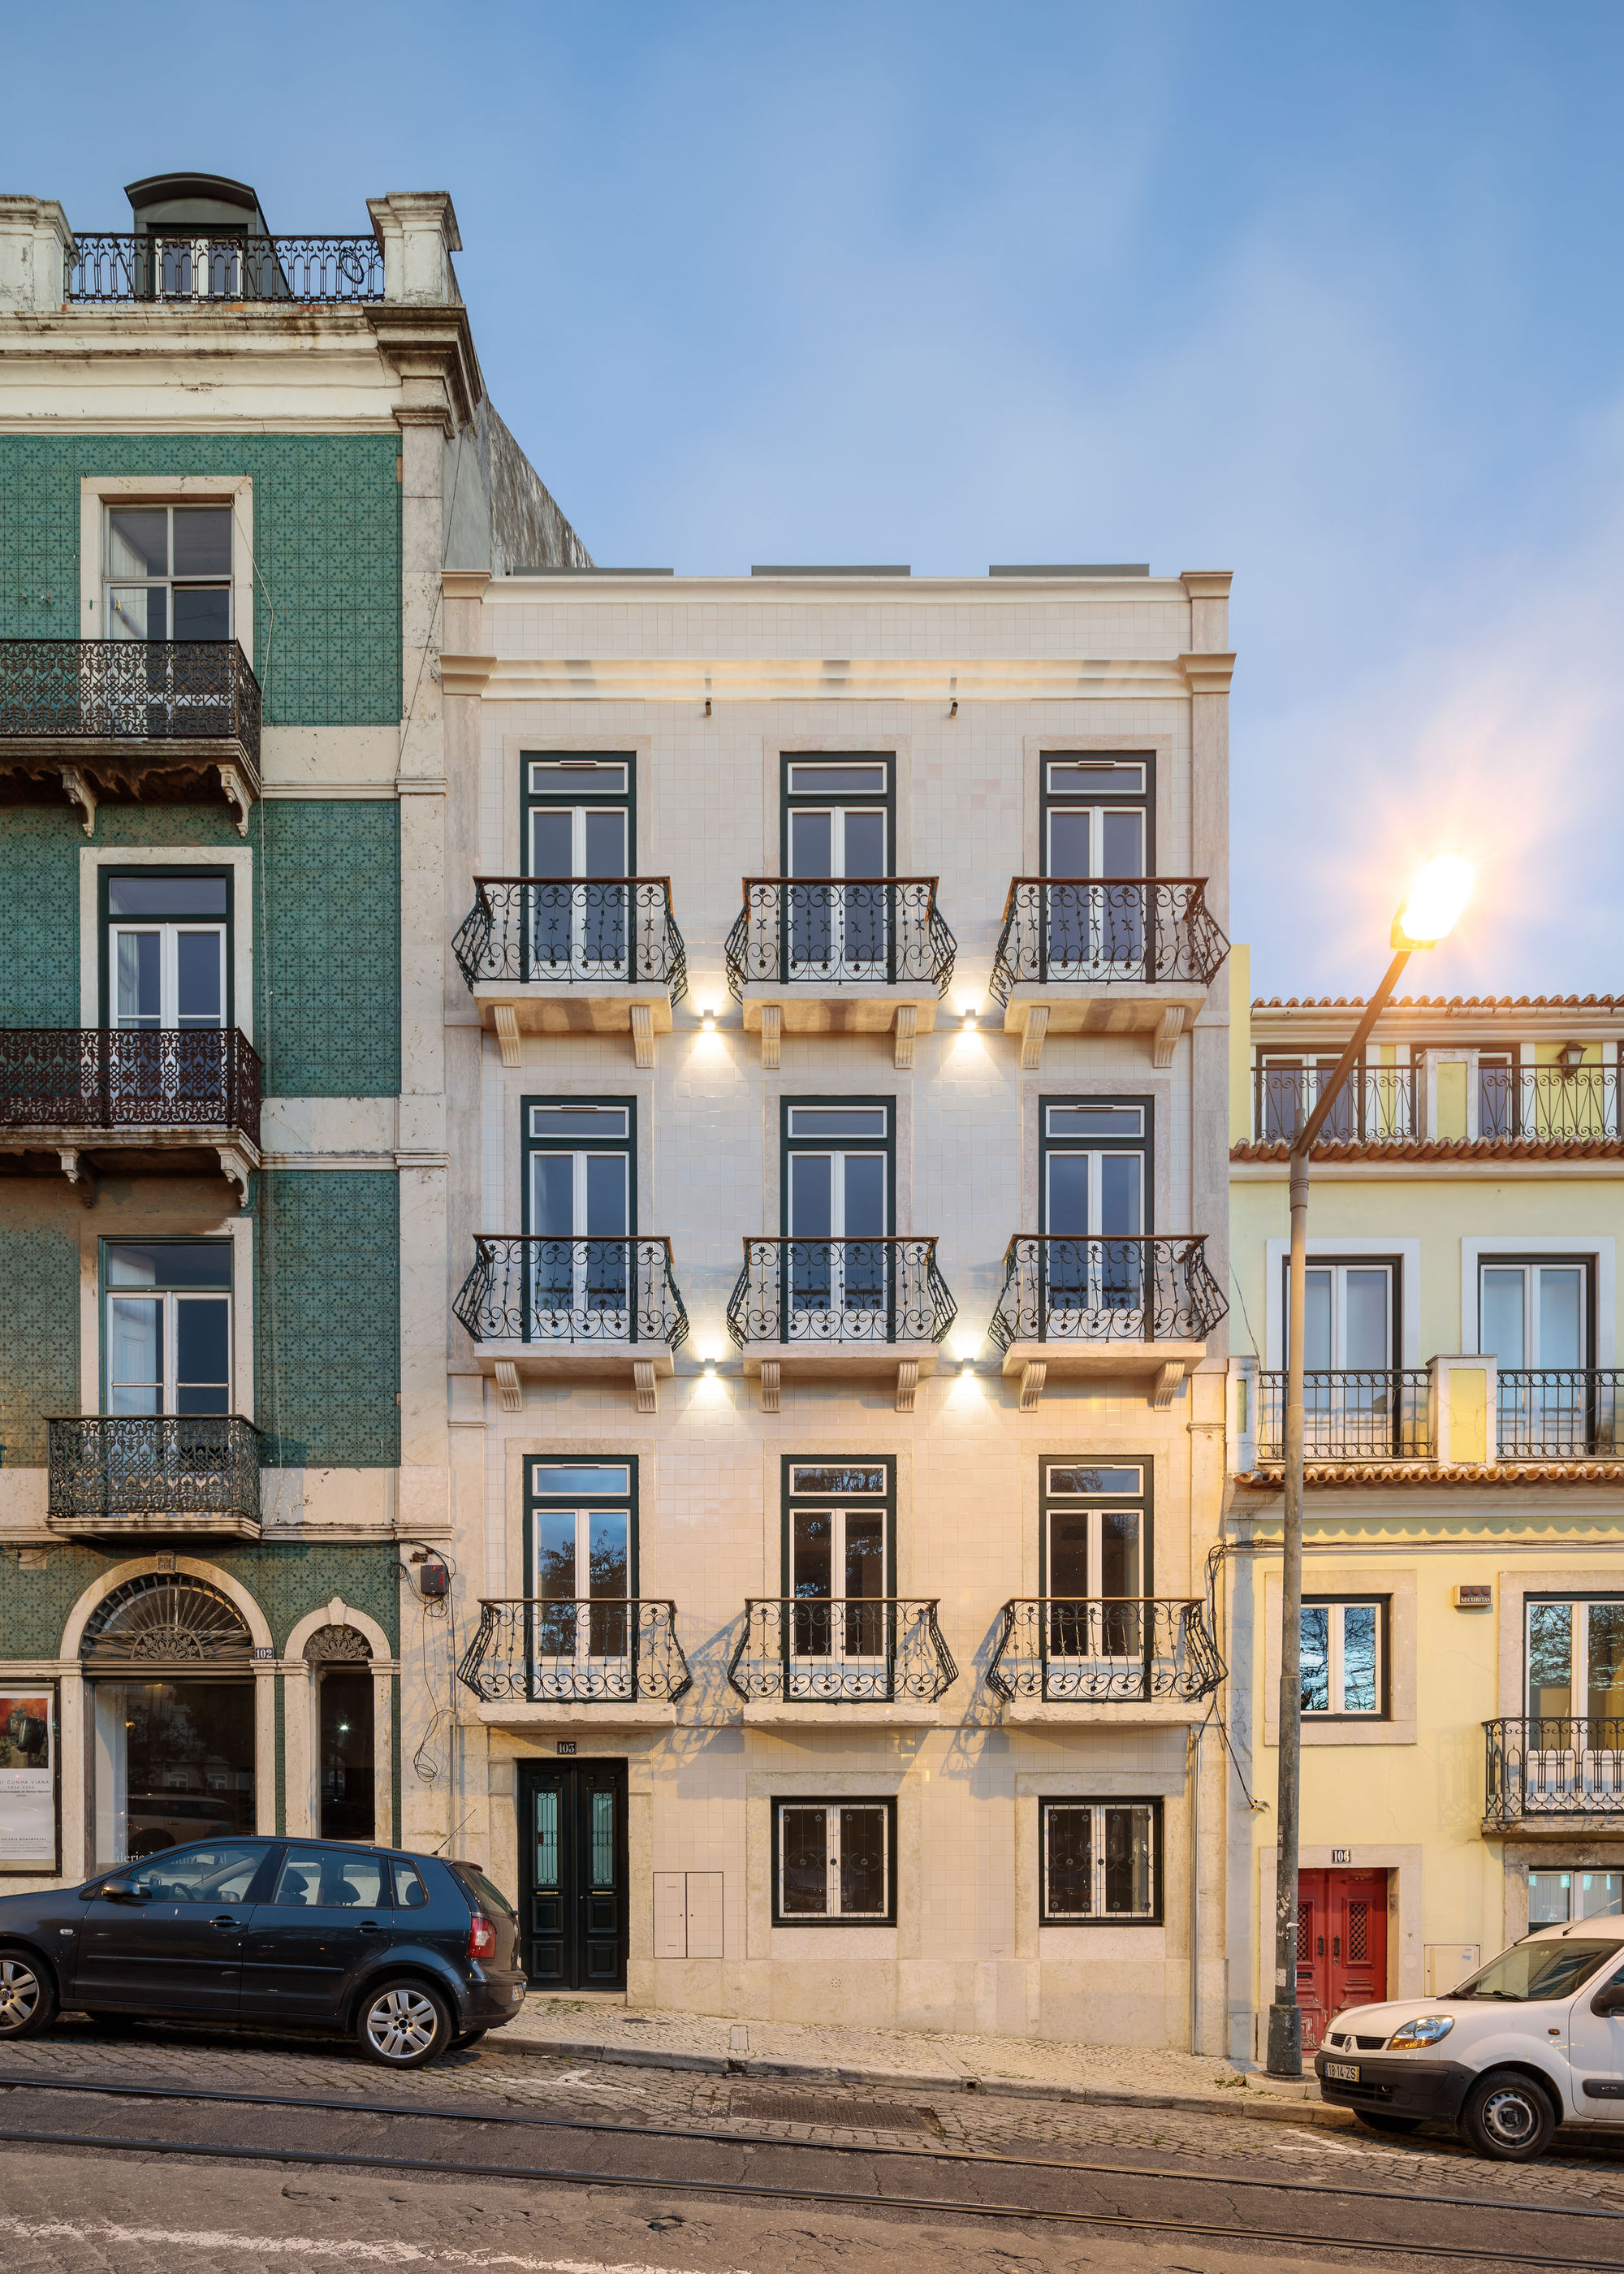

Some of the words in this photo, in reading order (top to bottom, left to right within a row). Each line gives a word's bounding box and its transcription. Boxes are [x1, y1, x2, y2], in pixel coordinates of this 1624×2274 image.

[256, 1649, 272, 1658] 102
[559, 1743, 575, 1753] 103
[1333, 1850, 1350, 1862] 106
